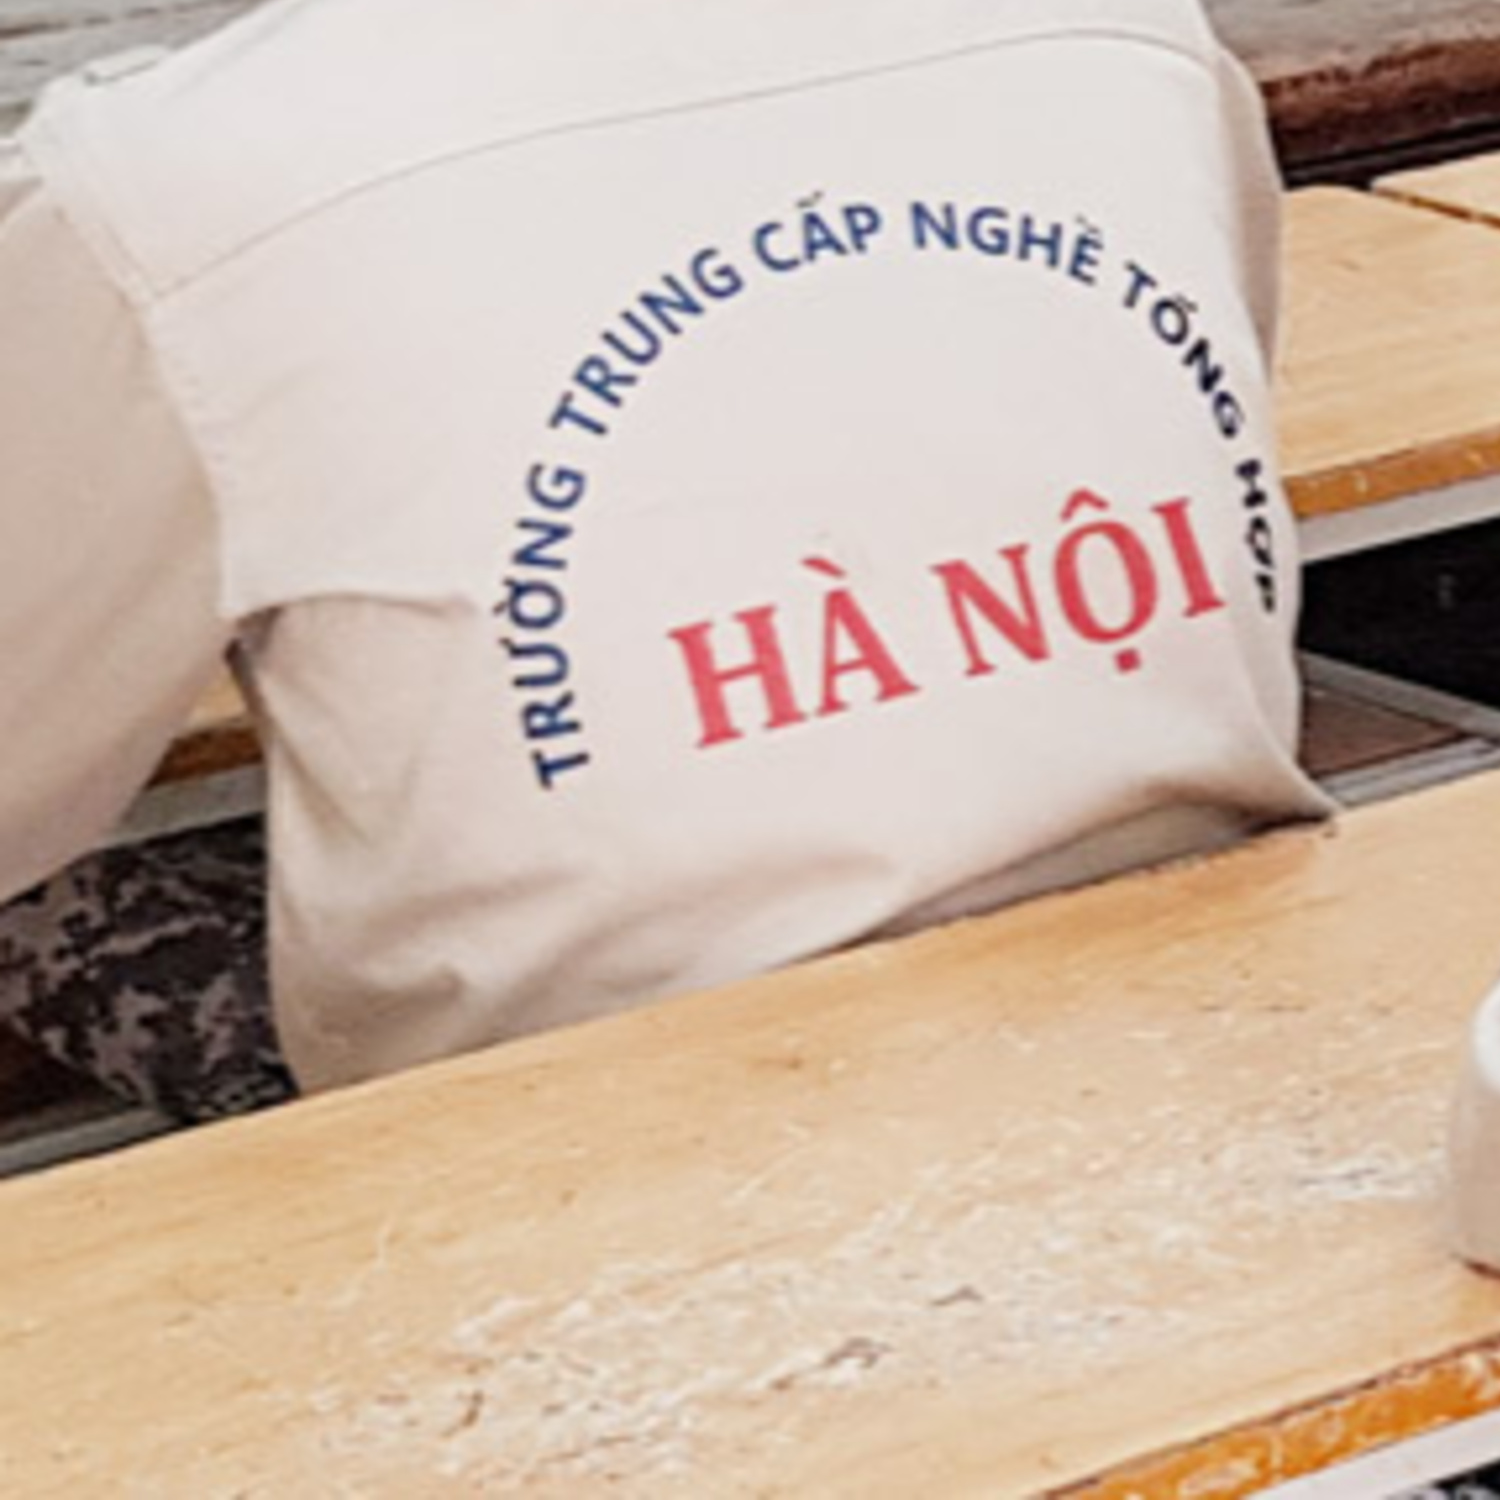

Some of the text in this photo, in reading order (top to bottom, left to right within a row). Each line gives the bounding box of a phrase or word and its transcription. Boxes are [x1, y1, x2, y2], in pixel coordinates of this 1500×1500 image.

[493, 462, 590, 790] TRƯỜNG
[549, 248, 744, 436] TRUNG
[752, 190, 882, 273] CẤP
[910, 201, 1104, 286] NGHỀ
[667, 486, 1228, 750] HÀ NỘI
